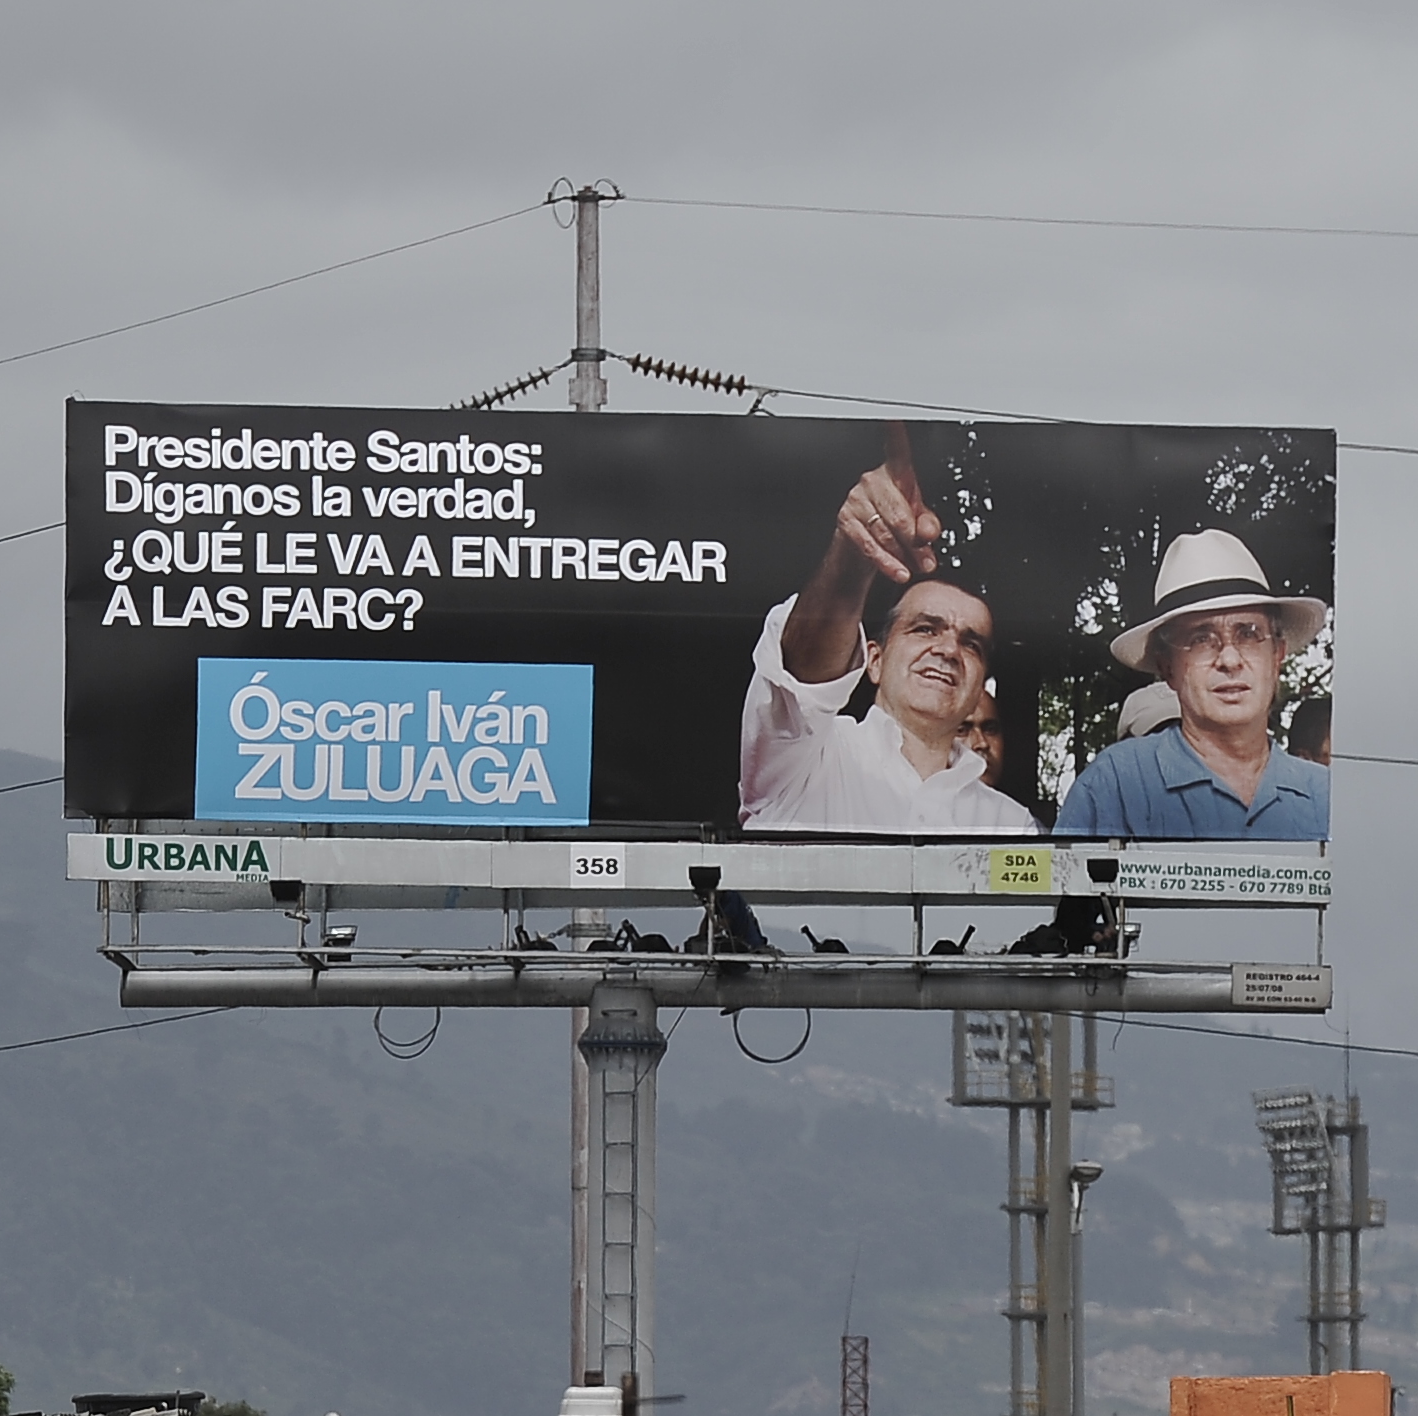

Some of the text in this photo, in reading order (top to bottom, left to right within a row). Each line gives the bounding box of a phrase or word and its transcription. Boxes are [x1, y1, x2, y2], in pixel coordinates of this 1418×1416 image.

[104, 425, 543, 475] Presidente Santos:
[104, 470, 538, 528] Díganos la verdad,
[103, 522, 728, 584] ¿QUÉ LE VA A ENTREGAR
[102, 585, 424, 632] A LAS FARC?
[229, 671, 549, 746] Óscar Iván
[234, 743, 557, 804] ZULUAGA
[106, 837, 270, 873] URBANA
[575, 857, 619, 876] 358
[1005, 855, 1037, 867] SDA
[1120, 862, 1331, 882] www.urbanamedia.com.co
[236, 873, 270, 883] MEDIA
[1000, 872, 1039, 883] 4746
[1119, 876, 1147, 889] PBX
[1160, 878, 1186, 891] 670
[1191, 879, 1225, 892] 2255
[1239, 881, 1265, 894] 670
[1270, 882, 1304, 895] 7789
[1309, 881, 1331, 896] Btá
